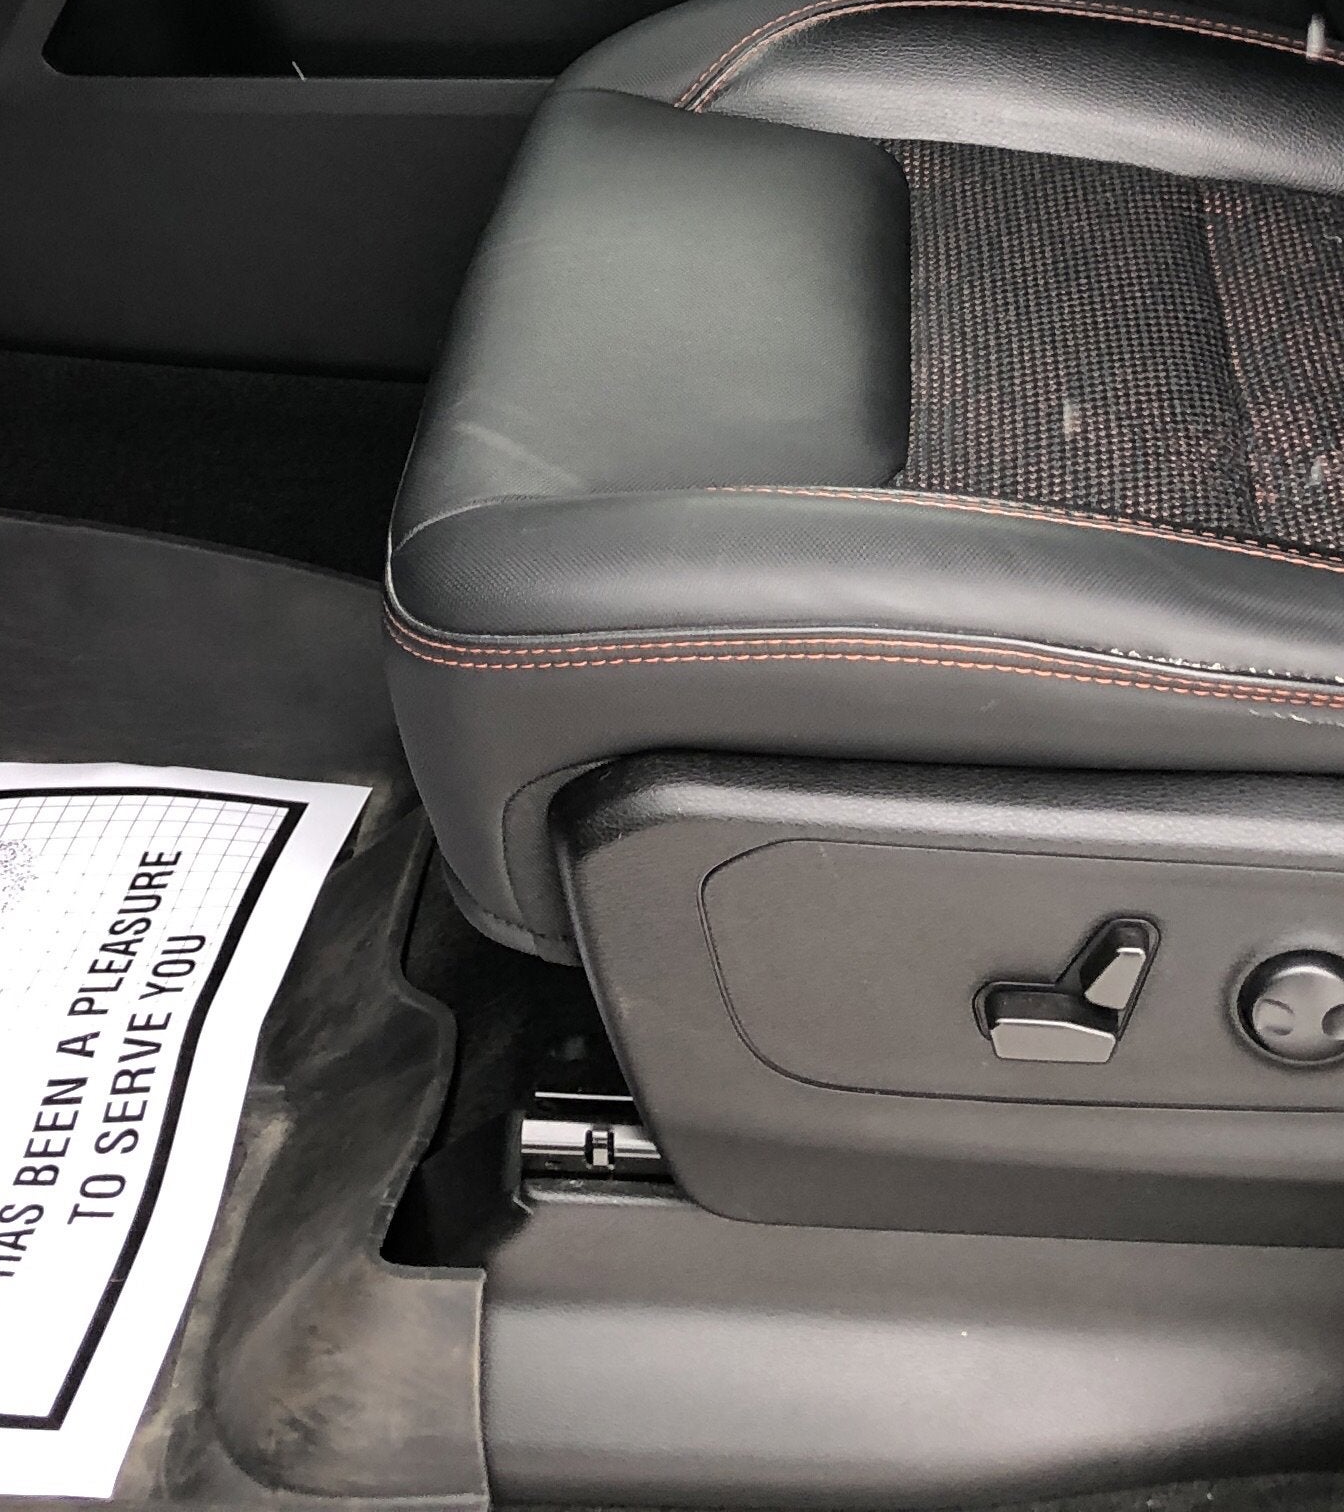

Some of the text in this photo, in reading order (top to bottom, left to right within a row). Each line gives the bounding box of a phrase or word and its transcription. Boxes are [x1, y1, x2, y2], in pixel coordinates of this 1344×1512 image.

[68, 851, 182, 1016] PLEASURE
[56, 1031, 101, 1058] A
[66, 934, 207, 1225] TO SERVE YOU
[12, 1076, 88, 1187] BEEN
